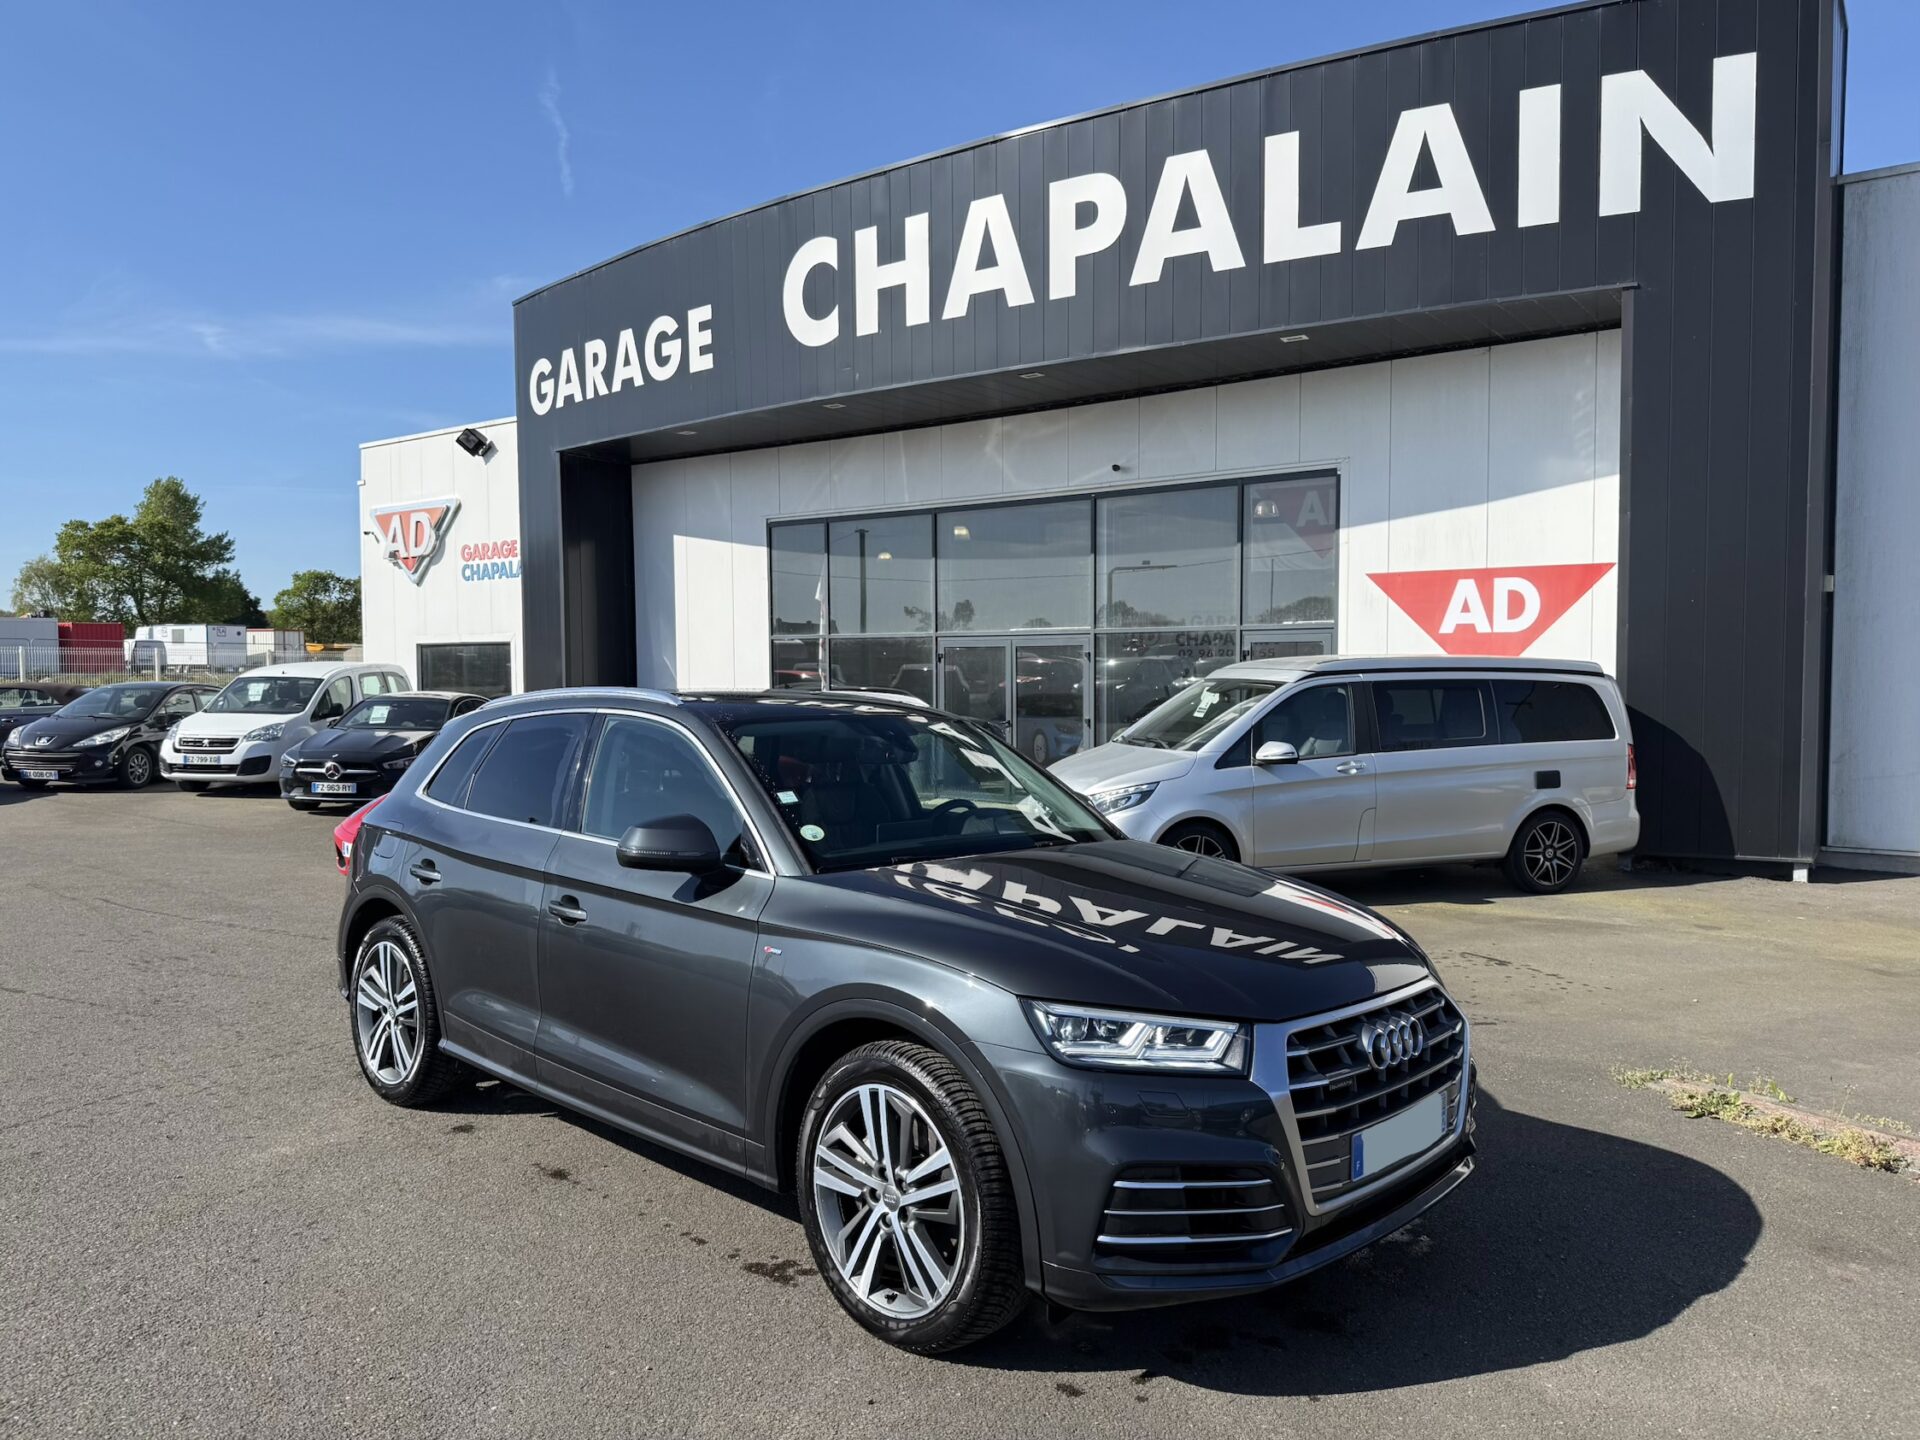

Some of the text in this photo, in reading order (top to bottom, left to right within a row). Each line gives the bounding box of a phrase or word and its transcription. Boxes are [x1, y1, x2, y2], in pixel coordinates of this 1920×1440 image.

[529, 51, 1758, 417] GARAGE CHAPALAIN
[383, 510, 435, 561] AD
[460, 539, 518, 562] GARAGE
[1438, 576, 1541, 635] AD
[1175, 631, 1236, 647] CHAPA
